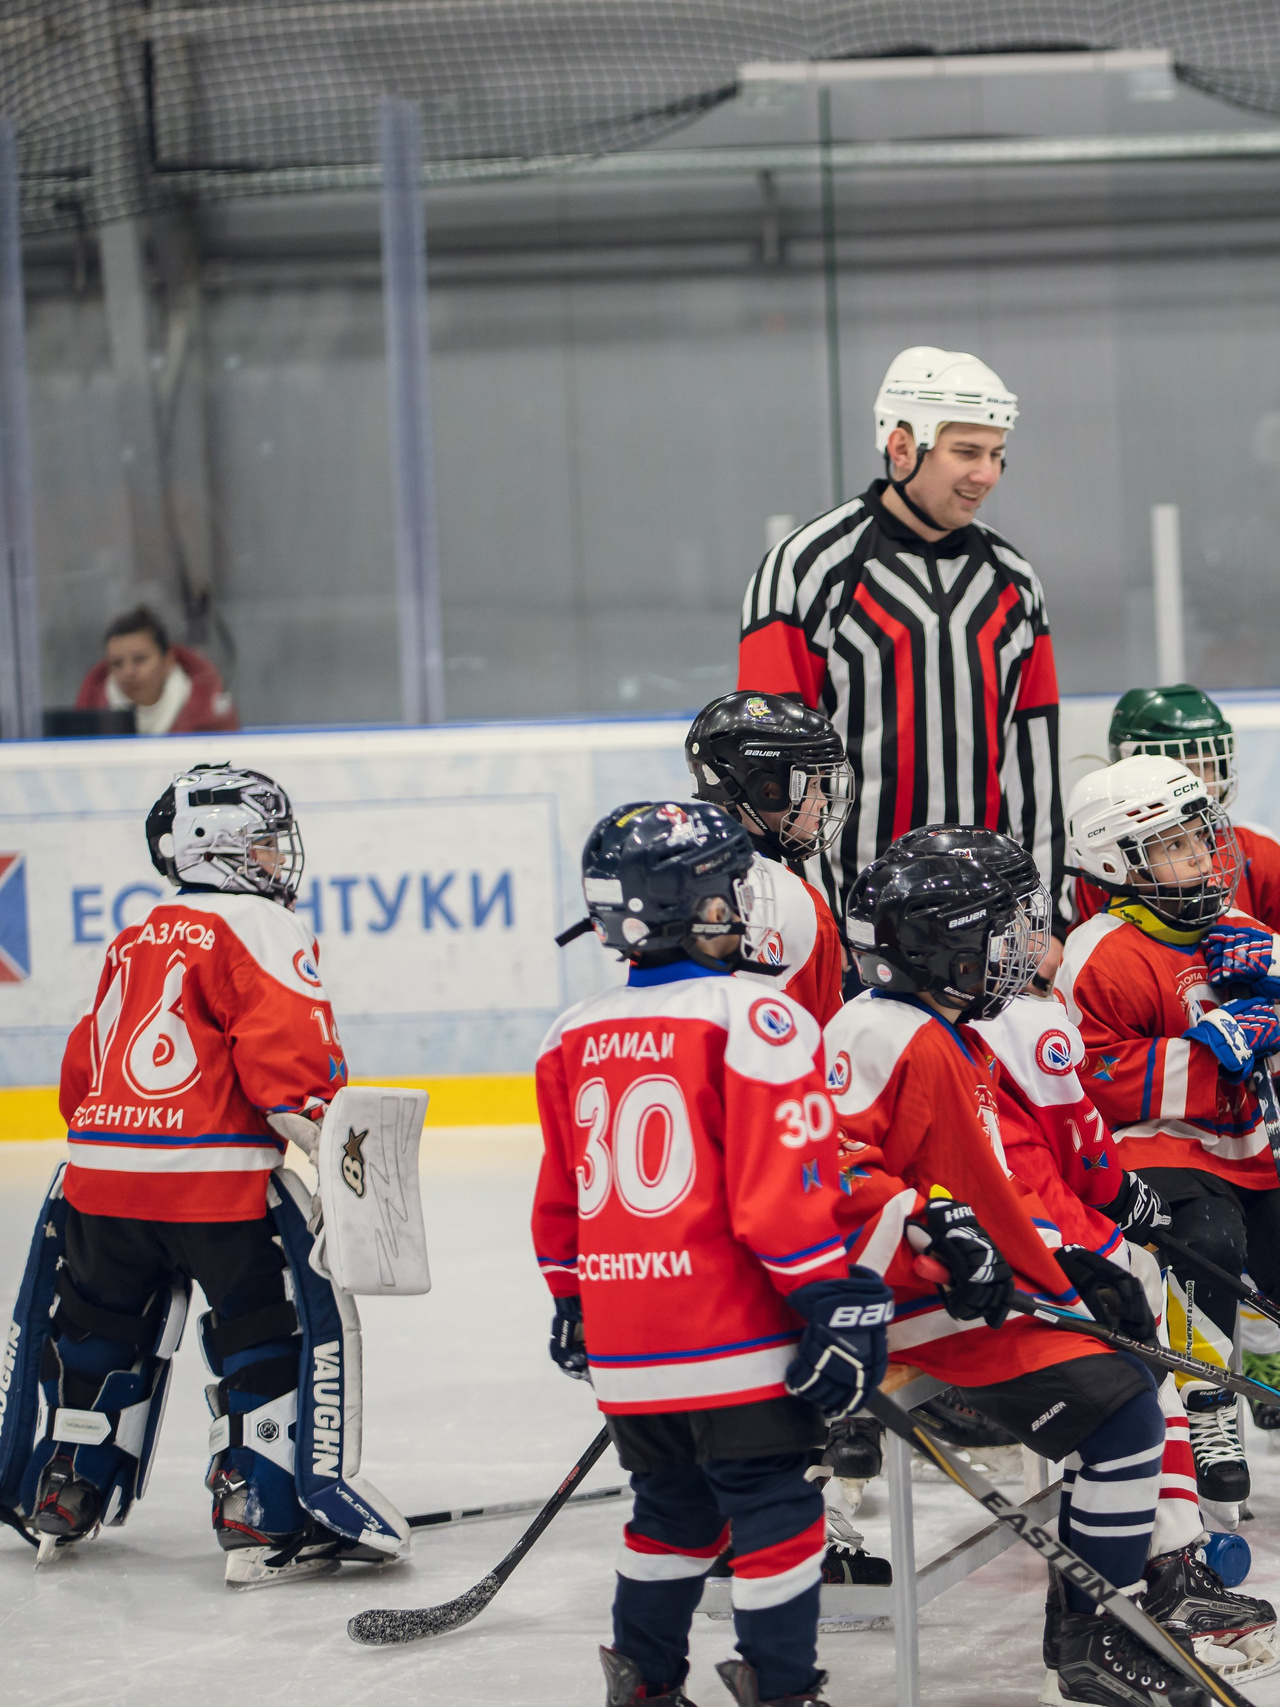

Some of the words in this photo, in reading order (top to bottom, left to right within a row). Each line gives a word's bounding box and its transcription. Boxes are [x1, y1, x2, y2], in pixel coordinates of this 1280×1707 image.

[1173, 781, 1200, 798] CCM
[1087, 826, 1106, 838] CCM
[73, 870, 515, 944] ЕСНТУКИ
[582, 1032, 675, 1067] ДЕЛИДИ
[775, 1092, 833, 1149] 30
[1064, 1107, 1105, 1153] 17
[575, 1074, 697, 1220] 30
[577, 1251, 692, 1281] ССЕНТУКИ
[312, 1340, 342, 1479] VAUGHN
[1031, 1401, 1068, 1432] BAUER
[982, 1490, 1120, 1607] EASTON
